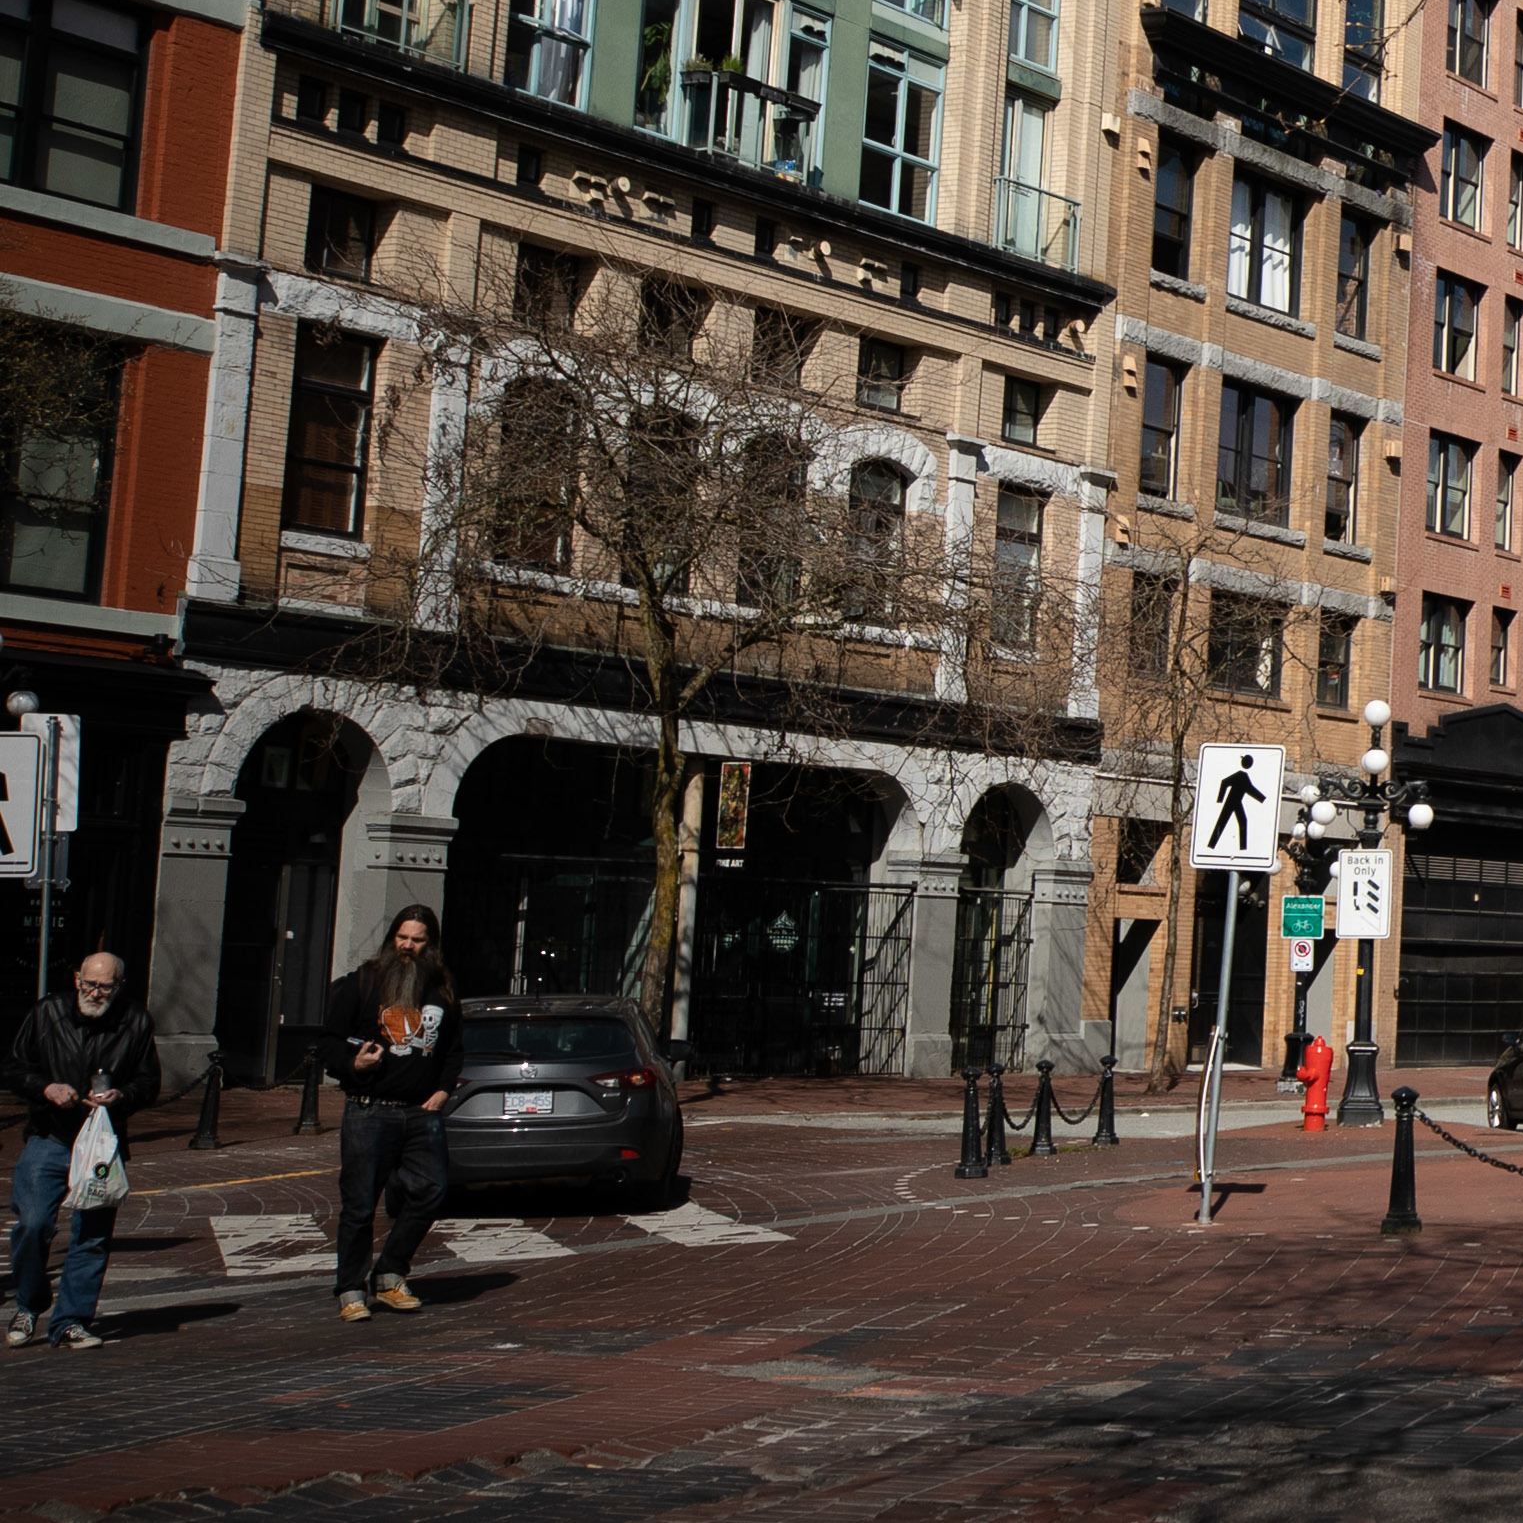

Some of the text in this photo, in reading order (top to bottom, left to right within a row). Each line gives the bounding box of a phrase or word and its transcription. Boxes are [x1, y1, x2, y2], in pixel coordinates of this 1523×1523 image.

[1347, 856, 1384, 865] Back in
[1354, 866, 1377, 877] Only
